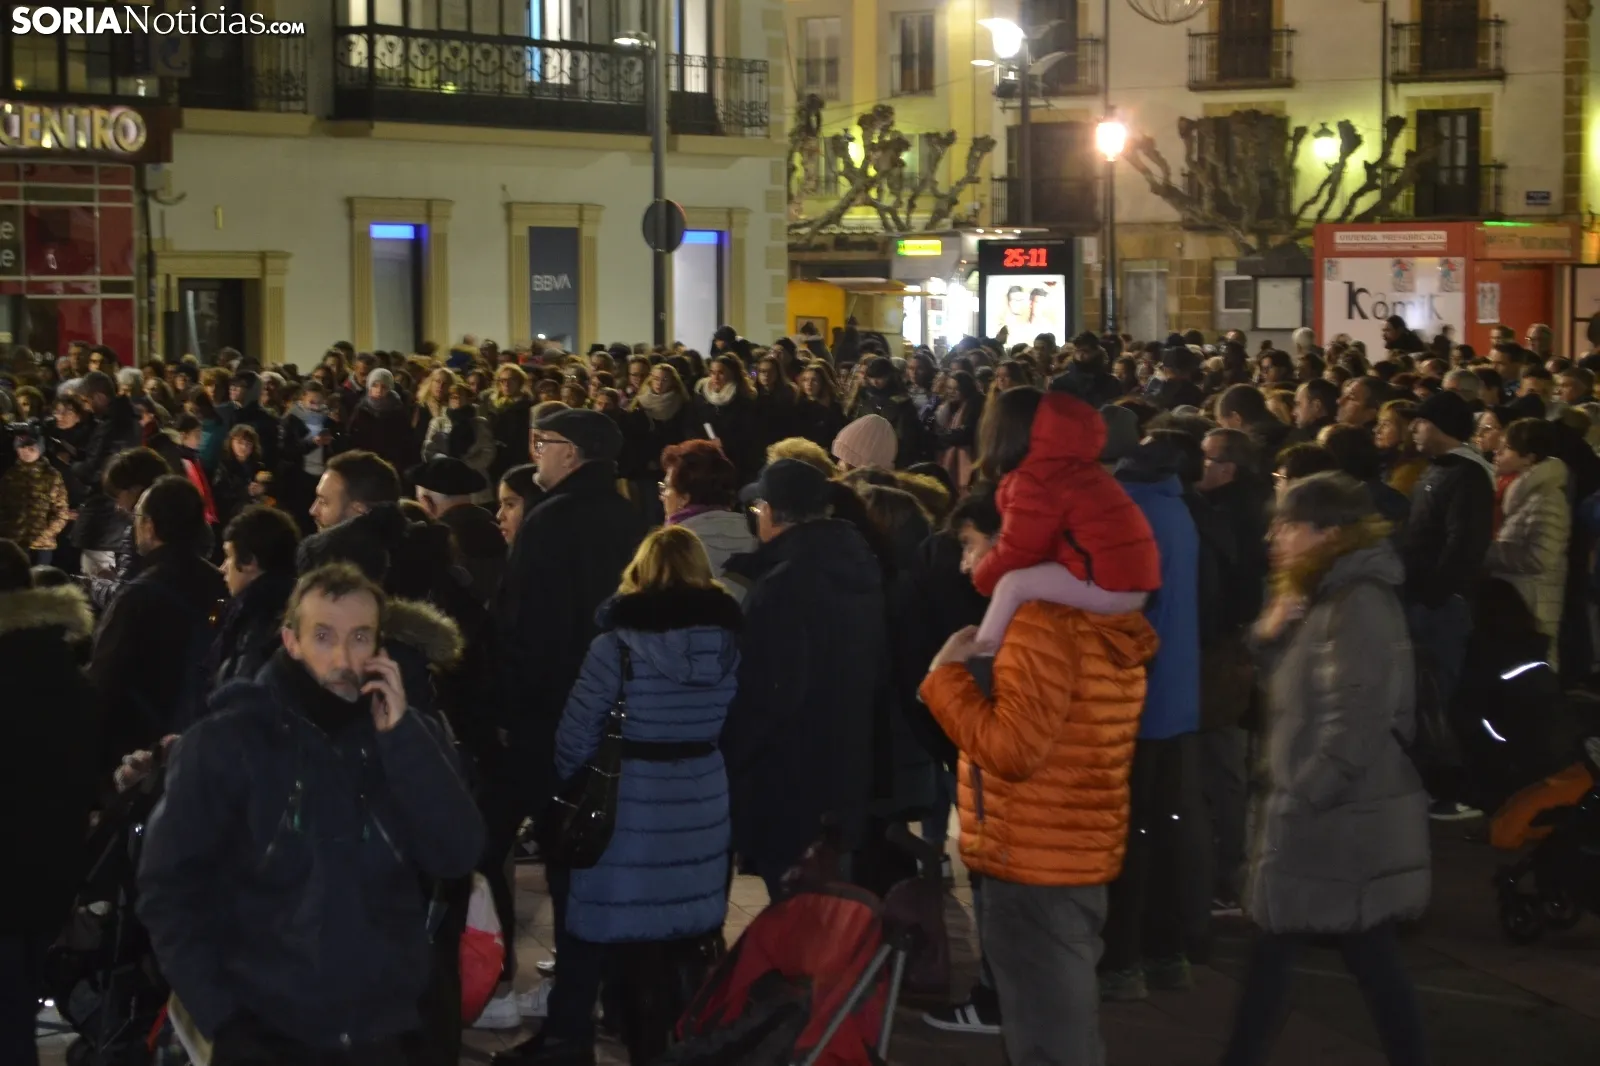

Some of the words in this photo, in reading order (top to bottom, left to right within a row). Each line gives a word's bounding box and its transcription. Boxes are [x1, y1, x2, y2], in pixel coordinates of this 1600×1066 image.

[0, 102, 147, 152] CENTRO
[1339, 232, 1379, 241] VIVIENDA
[1003, 248, 1048, 267] 25-11
[531, 274, 572, 292] BBVA
